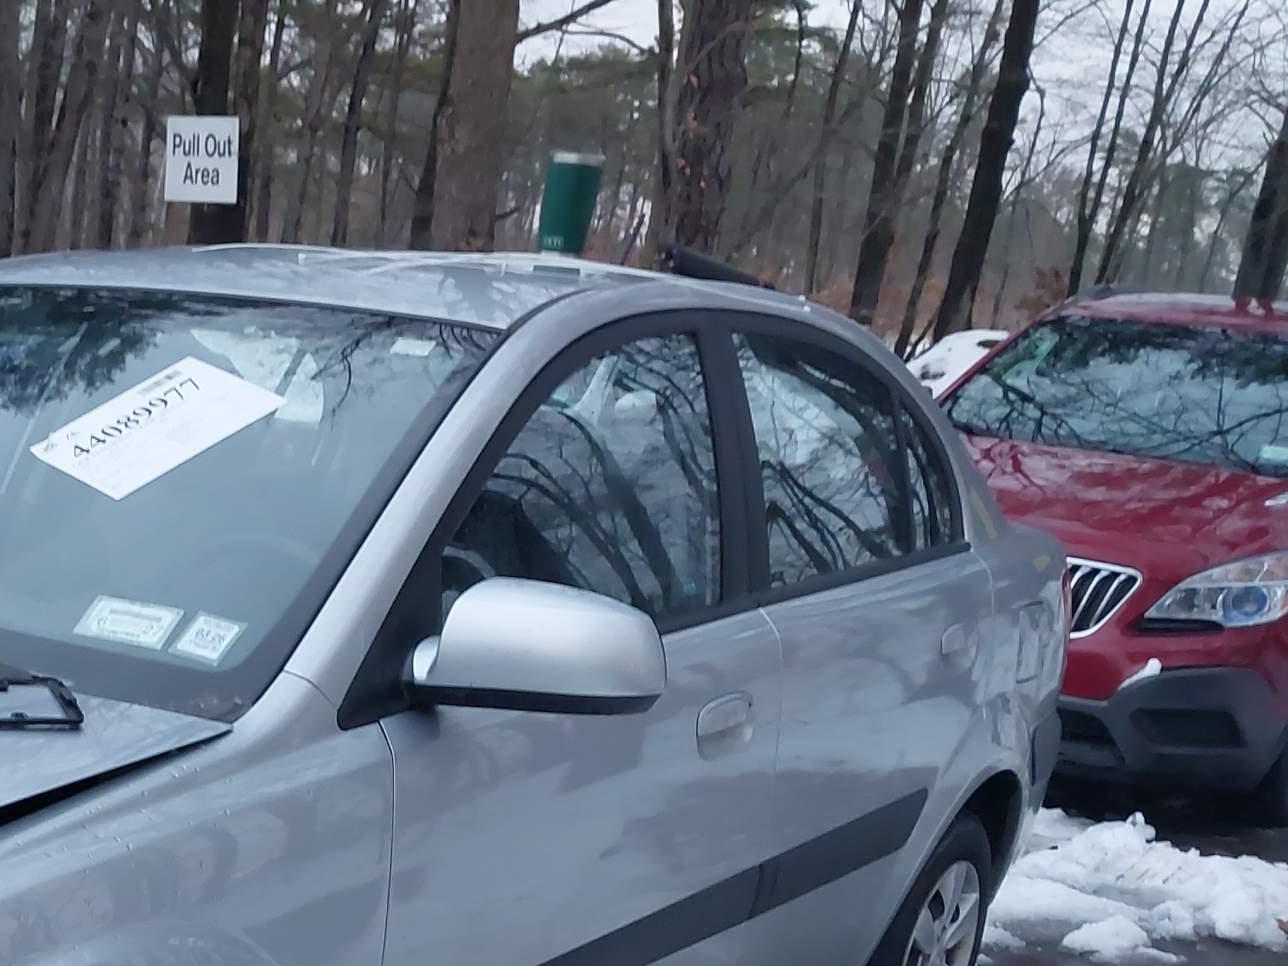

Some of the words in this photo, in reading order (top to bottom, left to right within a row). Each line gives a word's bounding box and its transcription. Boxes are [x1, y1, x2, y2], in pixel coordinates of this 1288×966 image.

[172, 132, 200, 157] Pull
[204, 132, 232, 158] Out
[183, 160, 220, 186] Area
[73, 377, 200, 458] 44089977
